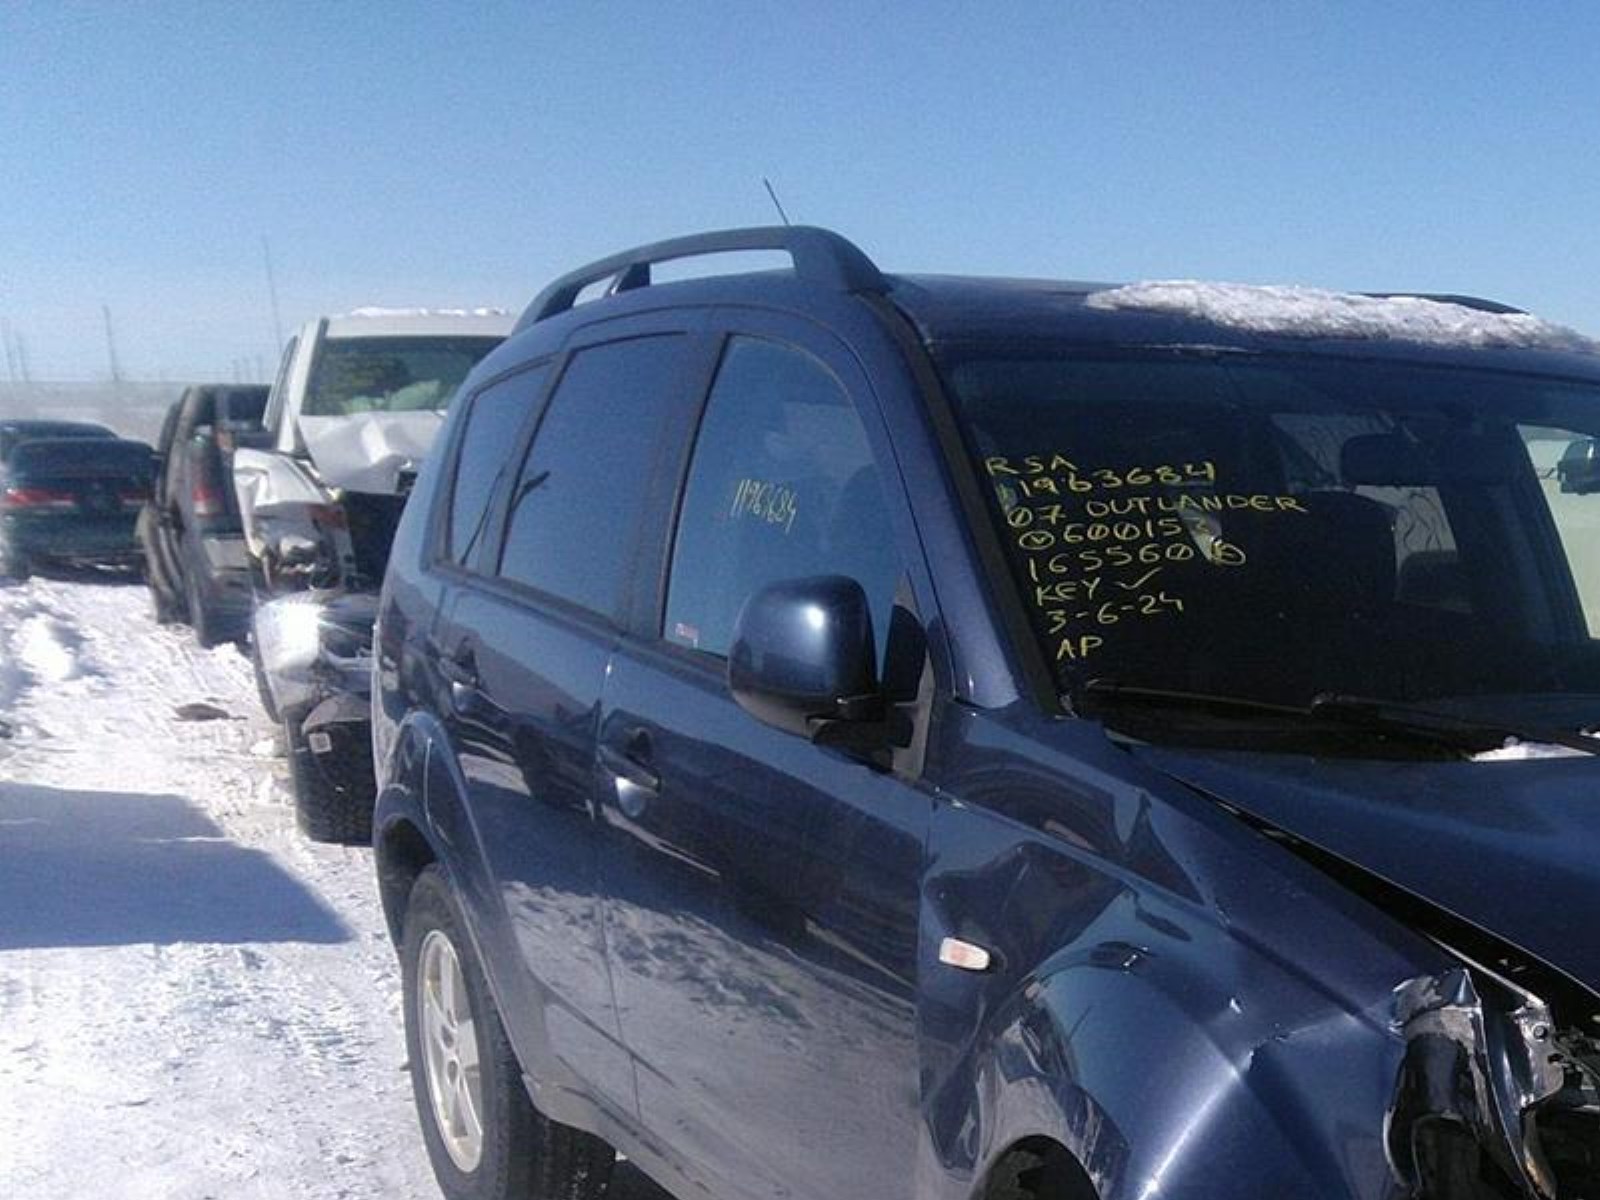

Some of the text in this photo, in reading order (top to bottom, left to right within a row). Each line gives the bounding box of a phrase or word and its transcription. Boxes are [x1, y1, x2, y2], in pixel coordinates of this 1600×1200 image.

[985, 455, 1078, 476] RSA
[1007, 494, 1308, 528] 07 OUTLANDER
[1036, 576, 1101, 606] KEY
